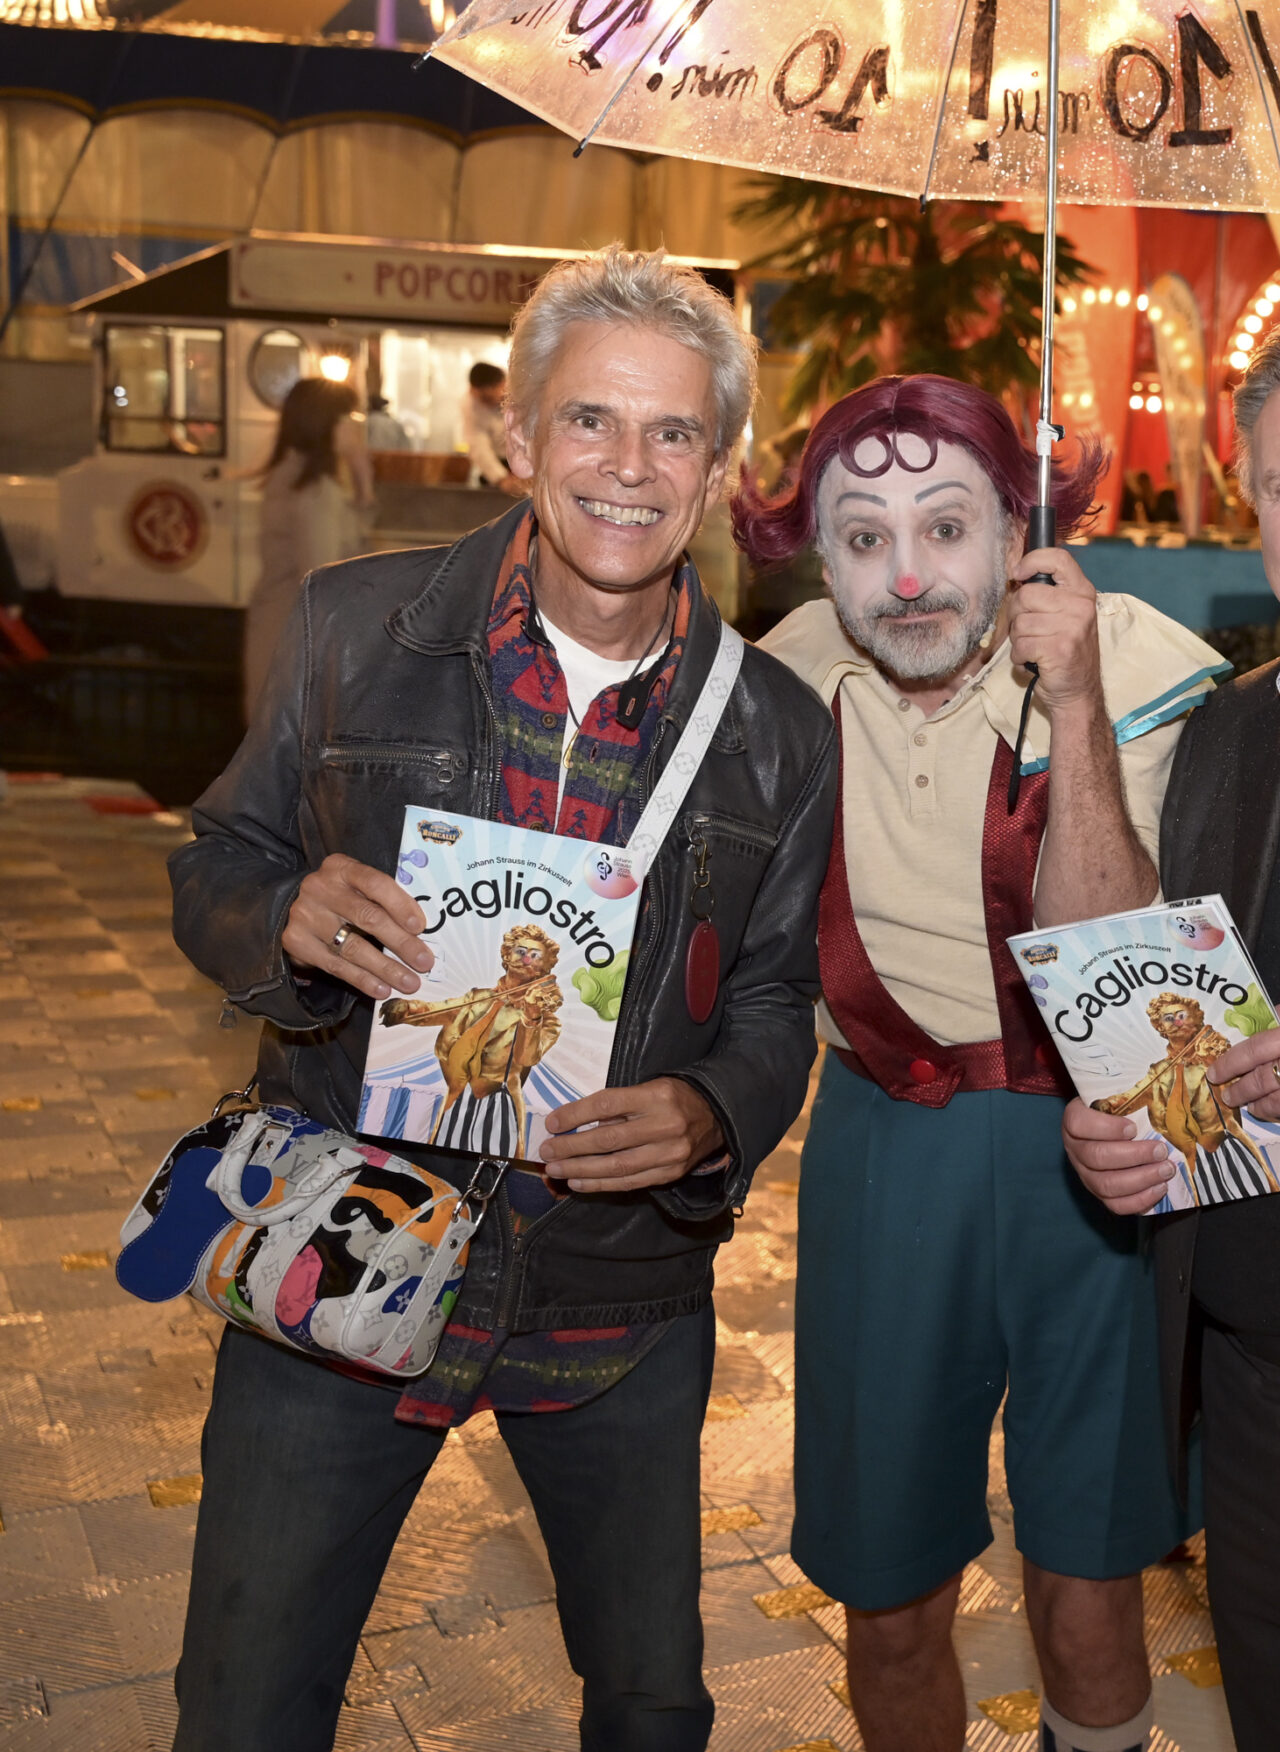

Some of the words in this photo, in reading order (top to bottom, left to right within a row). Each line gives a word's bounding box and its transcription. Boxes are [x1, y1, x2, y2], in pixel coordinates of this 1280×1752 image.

[466, 857, 494, 871] Johann
[496, 856, 526, 866] Strauss
[526, 859, 537, 869] im
[538, 863, 573, 887] Zirkuszelt
[1078, 955, 1099, 976] Johann
[1098, 945, 1124, 959] Strauss
[1135, 942, 1172, 953] Zirkuszelt
[1054, 956, 1249, 1042] Cagliostro
